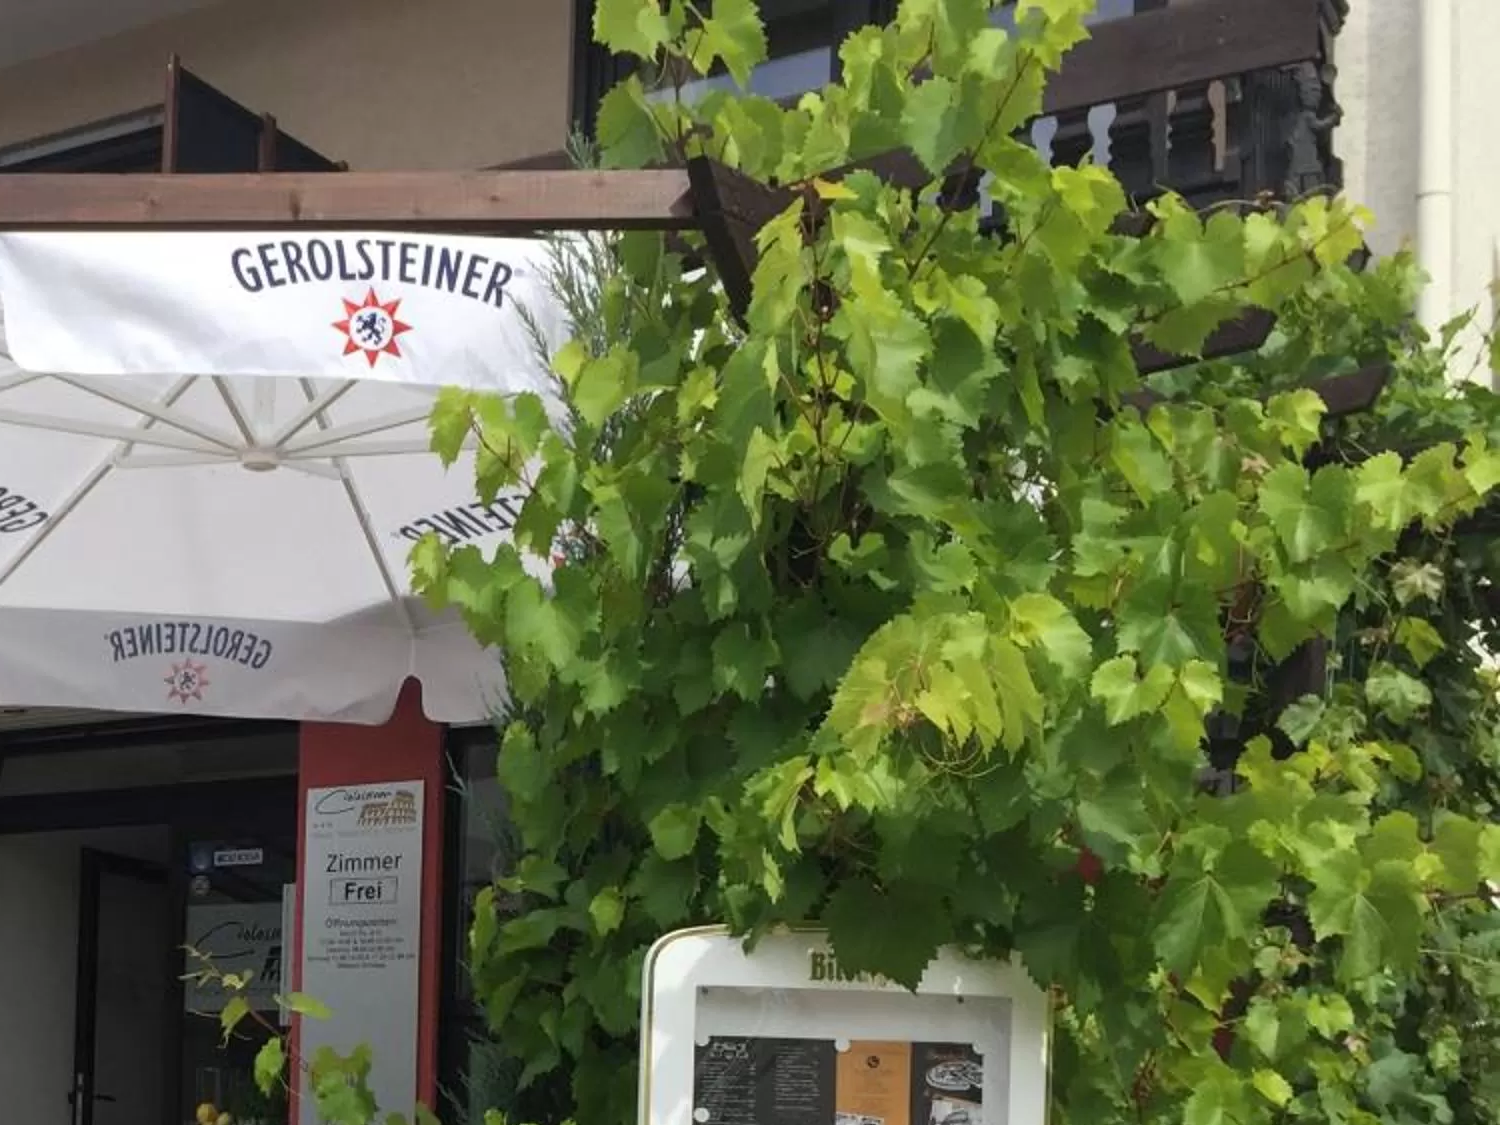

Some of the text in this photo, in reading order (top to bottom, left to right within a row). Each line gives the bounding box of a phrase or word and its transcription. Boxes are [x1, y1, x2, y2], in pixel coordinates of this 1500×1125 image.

[231, 238, 513, 308] GEROLSTEINER
[325, 852, 402, 873] Zimmer
[344, 881, 383, 901] Frei
